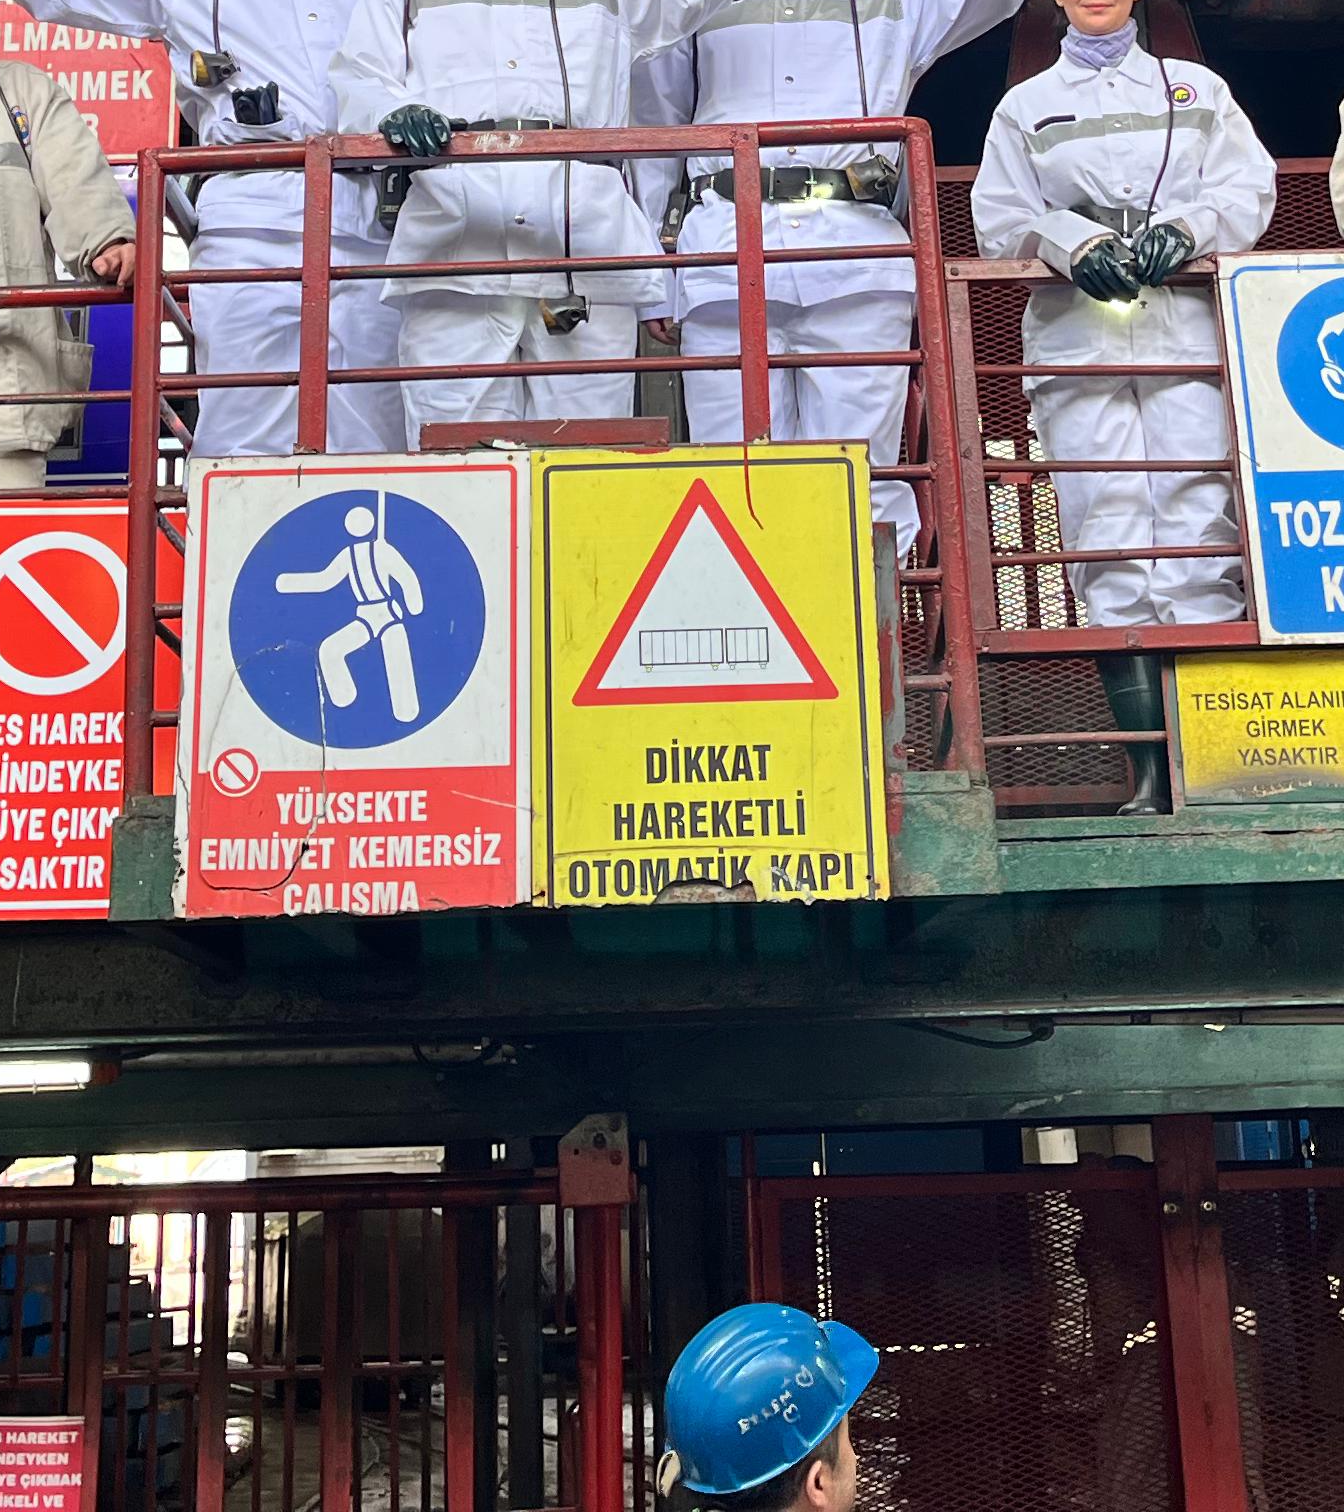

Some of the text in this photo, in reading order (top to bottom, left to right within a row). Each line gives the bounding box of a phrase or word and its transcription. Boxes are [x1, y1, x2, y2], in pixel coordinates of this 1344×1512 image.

[1192, 688, 1274, 711] TESİSAT
[29, 711, 125, 745] HAREK
[1246, 716, 1326, 738] GİRMEK
[646, 738, 771, 784] DİKKAT
[1238, 747, 1339, 766] YASAKTIR
[276, 787, 428, 825] YÜKSEKTE
[614, 790, 806, 841] HAREKETLİ
[51, 806, 119, 848] ÇIKM
[200, 826, 502, 871] EMNİYET KEMERSİZ
[569, 847, 854, 898] OTOMATİK KAPI
[6, 1432, 78, 1445] HAREKET
[20, 1473, 82, 1489] ÇIKMAK
[43, 1494, 64, 1508] VE
